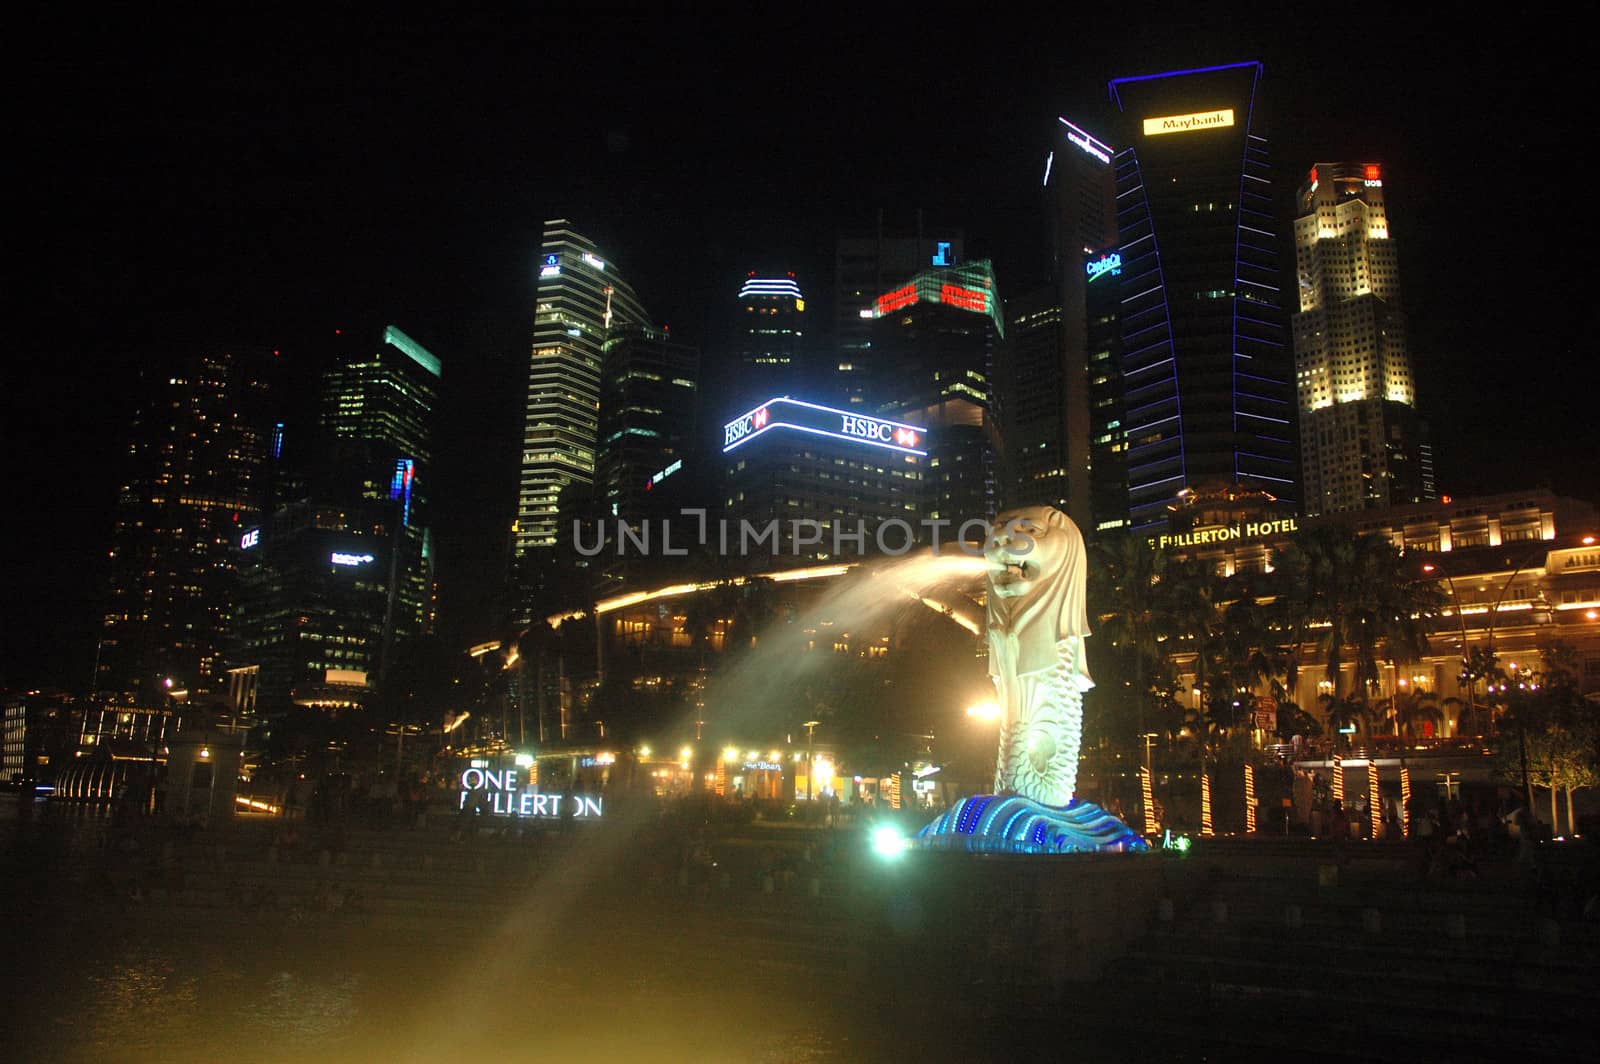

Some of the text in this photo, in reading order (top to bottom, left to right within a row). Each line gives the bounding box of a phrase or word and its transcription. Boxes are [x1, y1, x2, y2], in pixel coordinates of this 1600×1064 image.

[1162, 113, 1225, 129] Maybank
[724, 415, 753, 445] HSBC
[841, 415, 893, 442] HSBC
[1159, 527, 1241, 549] FULLERTON
[1246, 518, 1298, 537] HOTEL
[461, 768, 517, 791] ONE
[460, 791, 602, 817] FLLERTN
